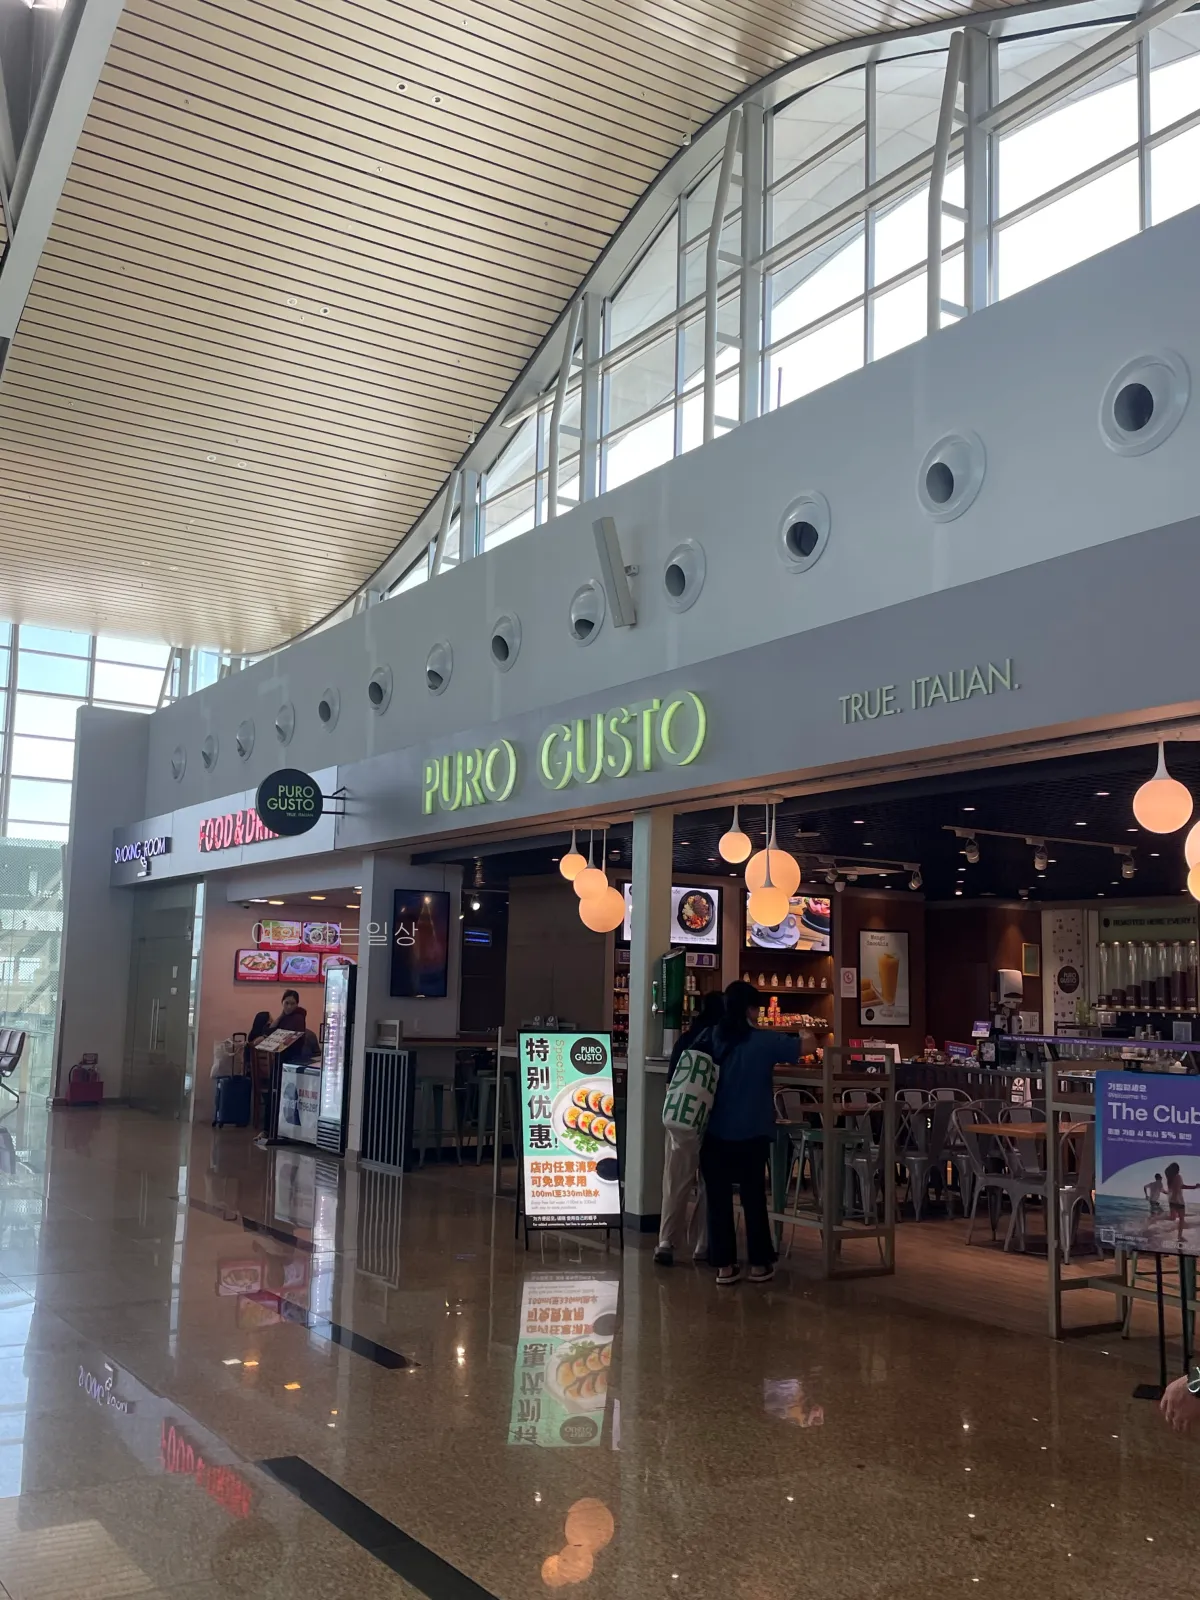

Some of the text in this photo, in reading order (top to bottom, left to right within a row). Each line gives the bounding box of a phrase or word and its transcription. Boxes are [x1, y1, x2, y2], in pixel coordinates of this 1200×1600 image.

[838, 658, 1020, 724] TRUE. ITALIAN.
[422, 690, 707, 814] PURO GUSTO
[278, 785, 314, 798] PURO
[266, 798, 315, 811] GUSTO
[144, 838, 166, 857] ROOM
[580, 1046, 602, 1054] PURO
[574, 1053, 603, 1062] GUSTO
[1108, 1102, 1200, 1124] The Club
[530, 1160, 597, 1174] 店内任意消费
[530, 1175, 587, 1188] 可免费享用
